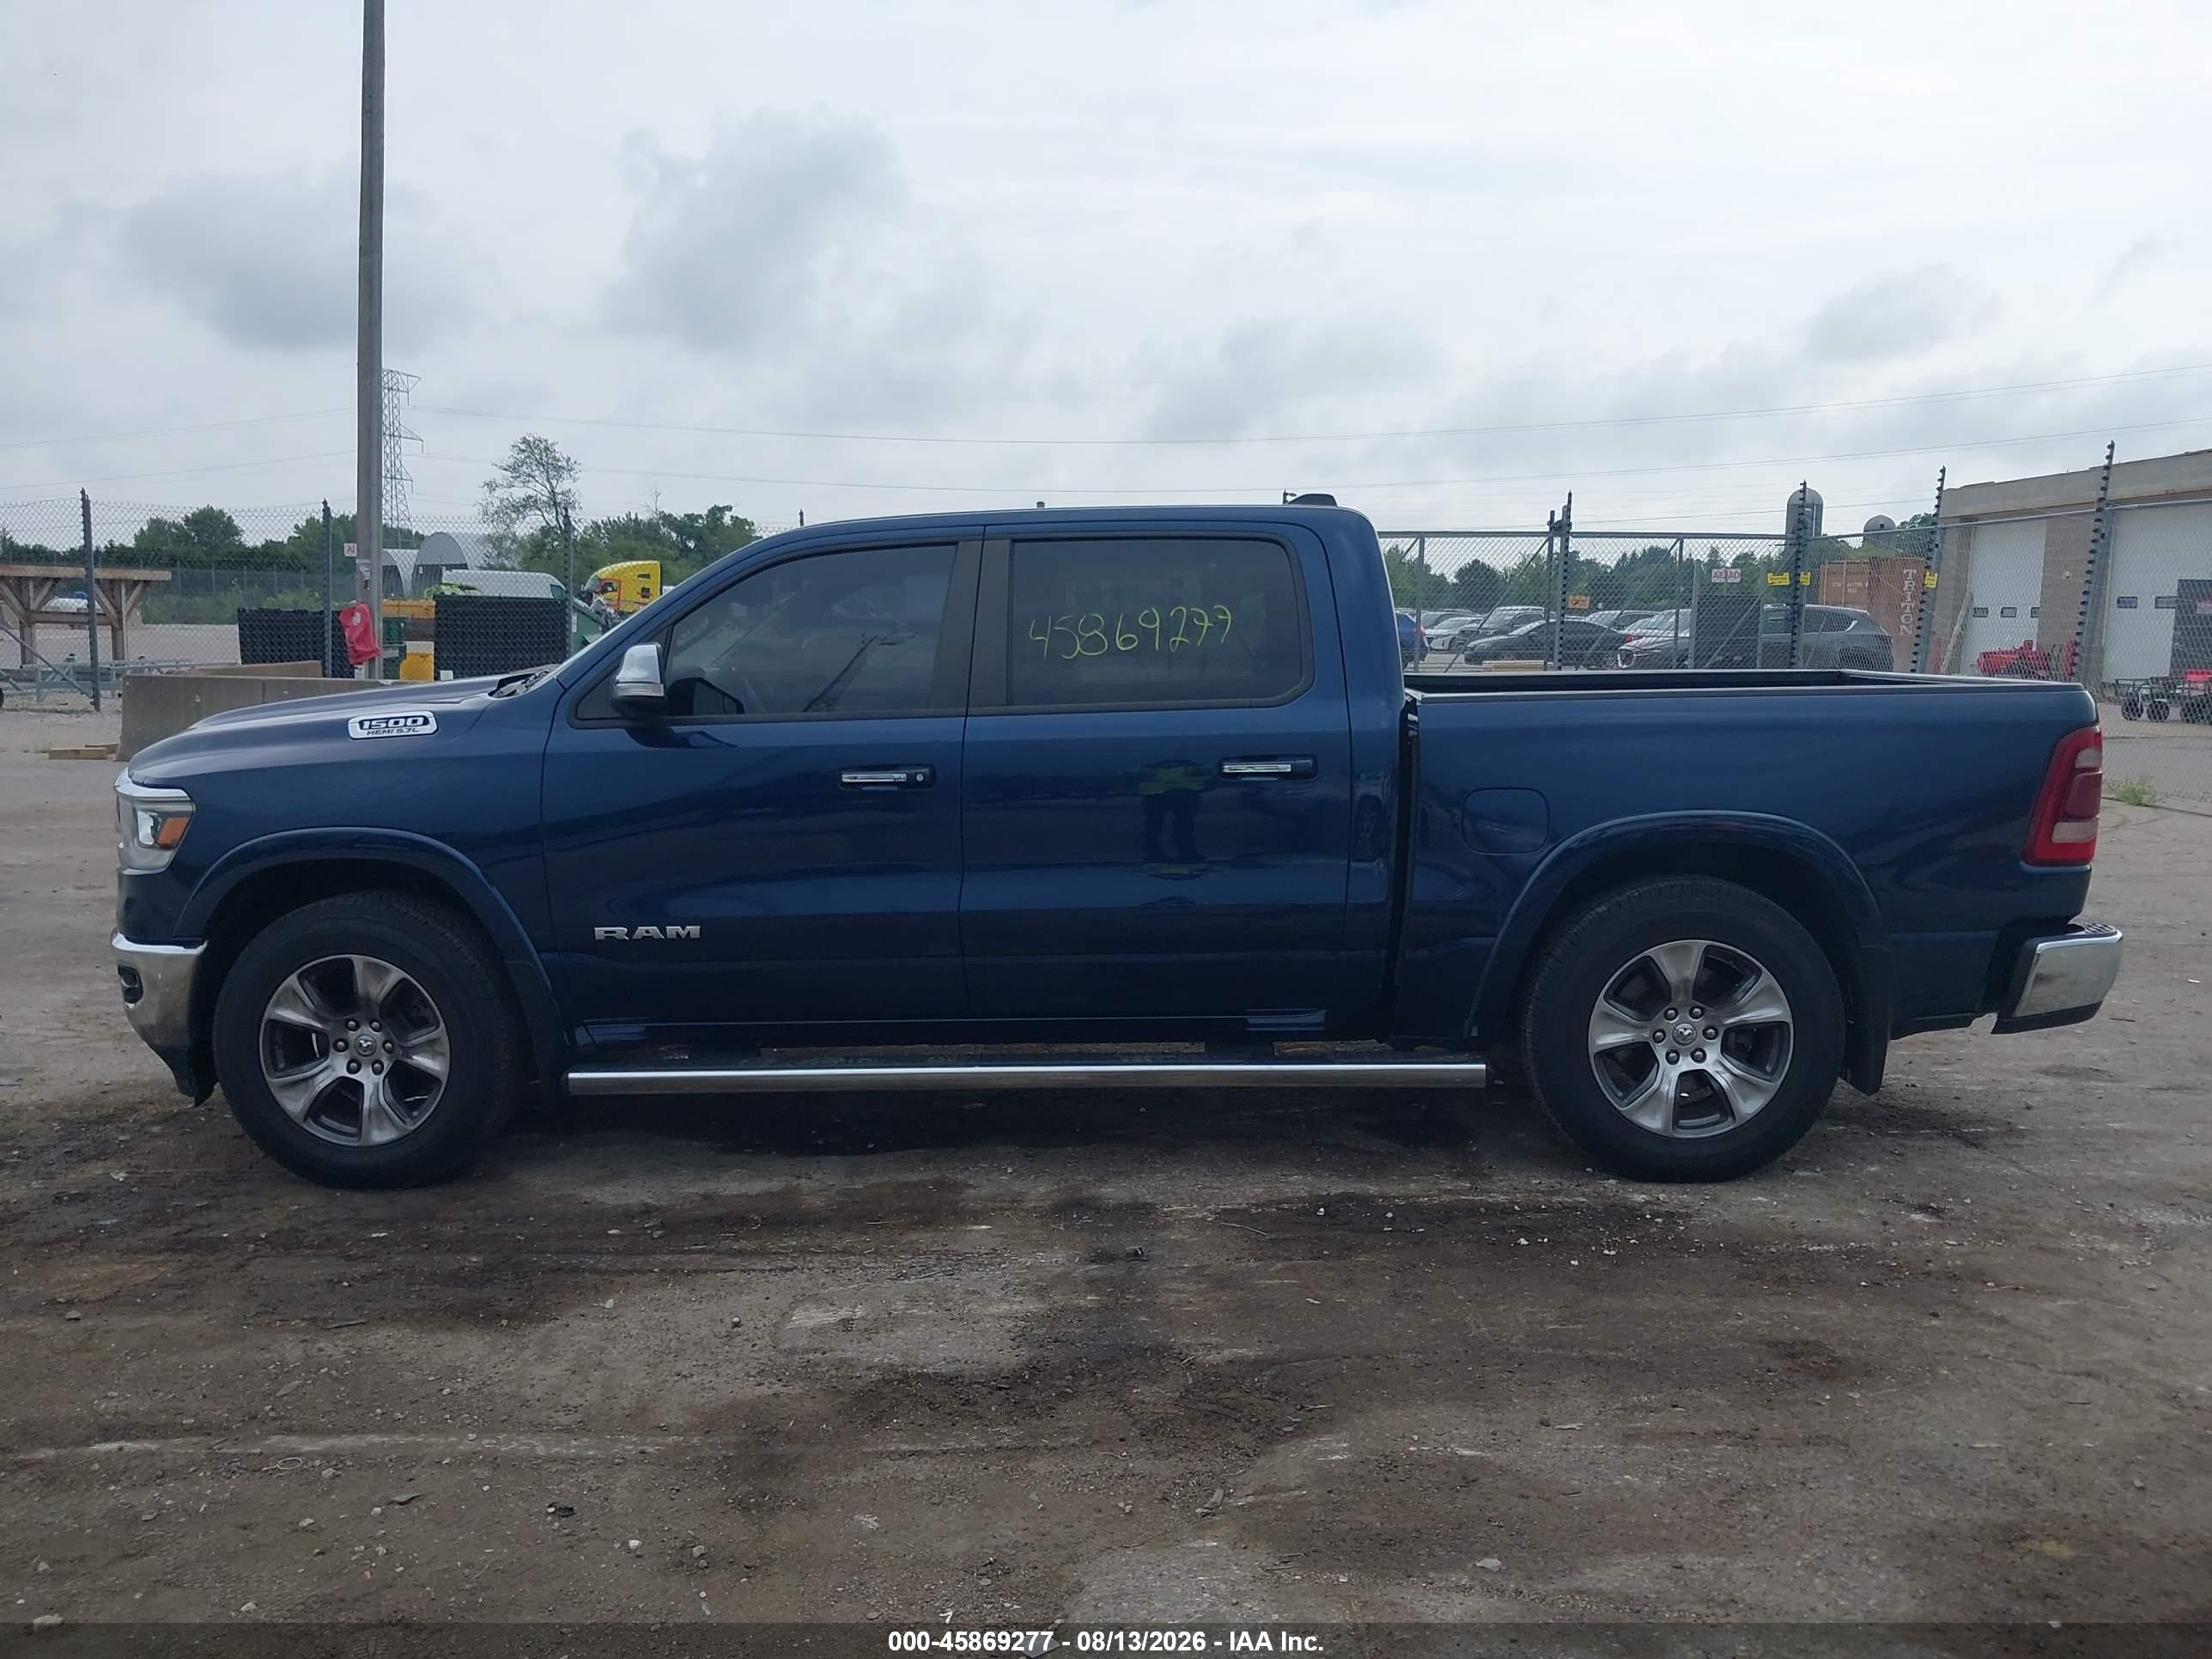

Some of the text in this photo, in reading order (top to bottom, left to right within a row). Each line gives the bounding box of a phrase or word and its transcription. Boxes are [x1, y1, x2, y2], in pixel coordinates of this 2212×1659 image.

[1030, 605, 1232, 659] 45869277
[362, 716, 425, 730] 1500
[594, 926, 702, 940] RAM
